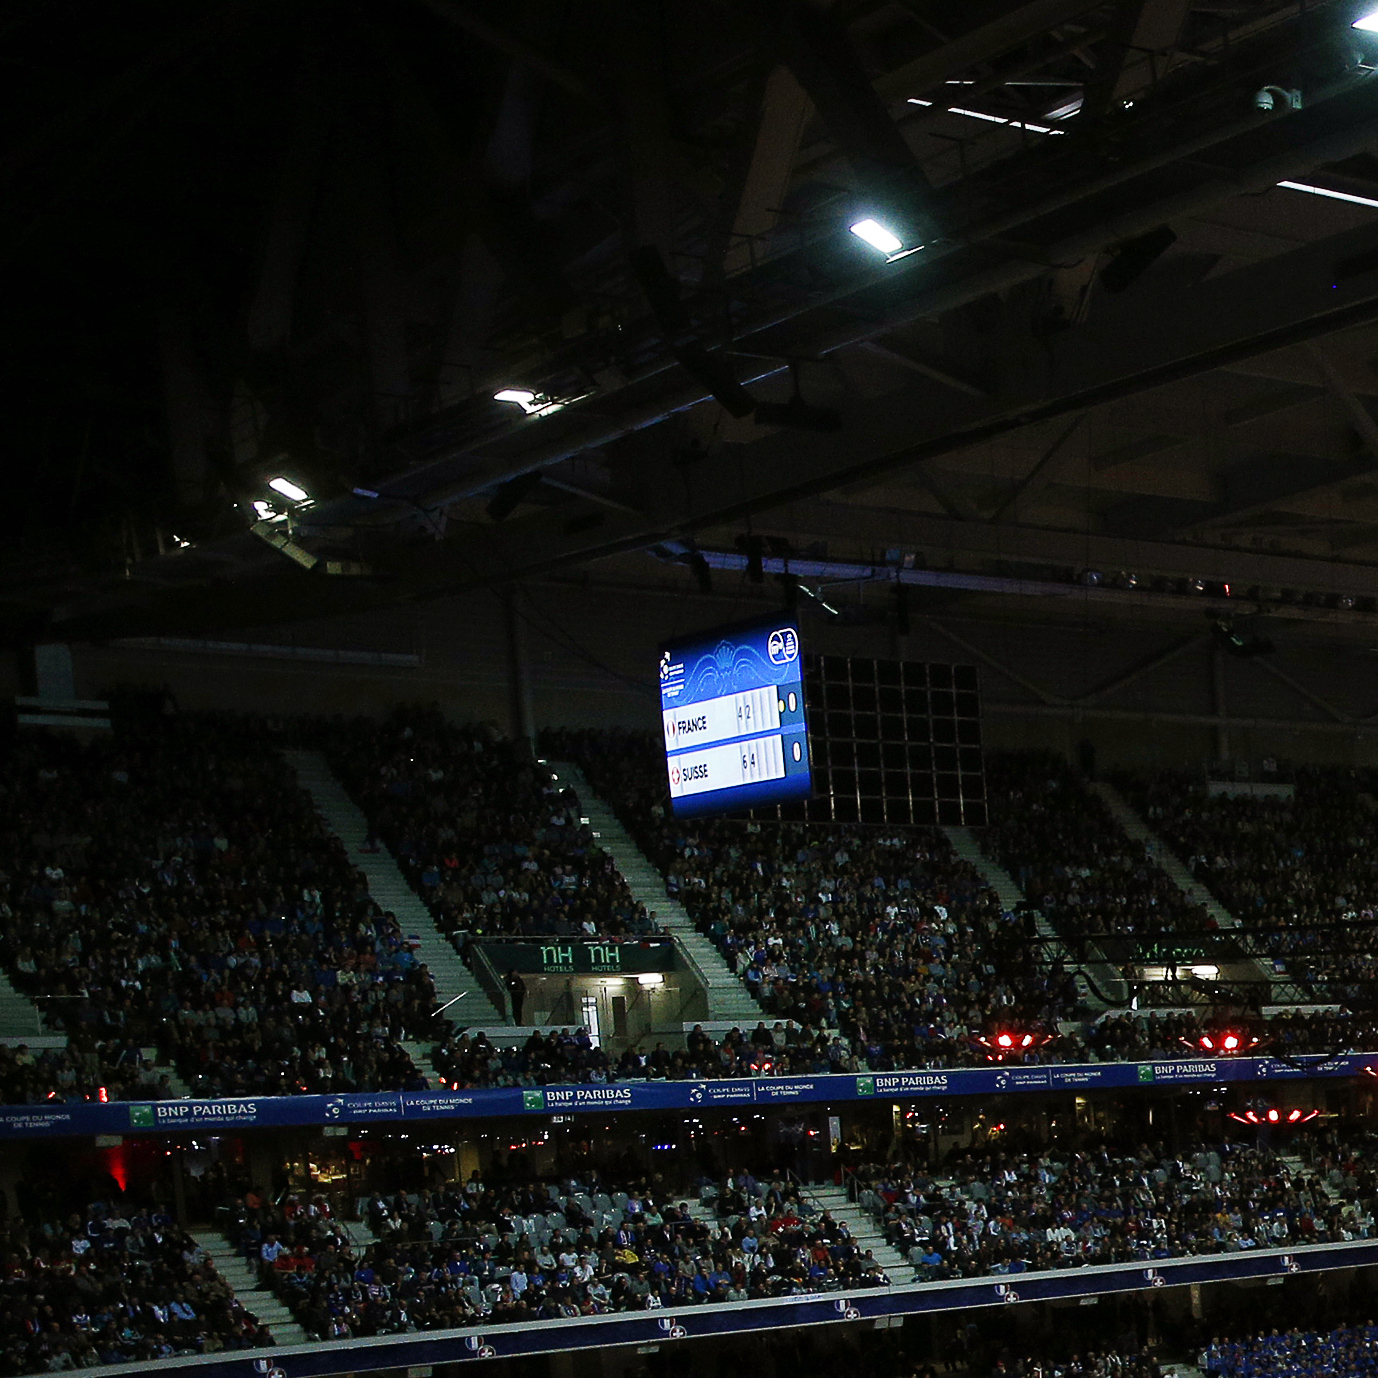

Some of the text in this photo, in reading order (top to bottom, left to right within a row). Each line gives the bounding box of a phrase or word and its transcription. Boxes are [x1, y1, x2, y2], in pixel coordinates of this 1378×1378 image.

[677, 715, 707, 736] FRANCE
[738, 705, 743, 721] 4
[745, 704, 751, 719] 2
[682, 763, 709, 782] SUISSE
[742, 754, 748, 769] 6
[750, 753, 756, 768] 4
[543, 964, 574, 973] HOTELS
[591, 964, 622, 972] HOTELS
[1154, 1063, 1216, 1074] BNP PARIBAS
[876, 1075, 948, 1087] BNP PARIBAS
[546, 1088, 632, 1101] BNP PARIBAS
[157, 1103, 257, 1117] BNP PARIBAS
